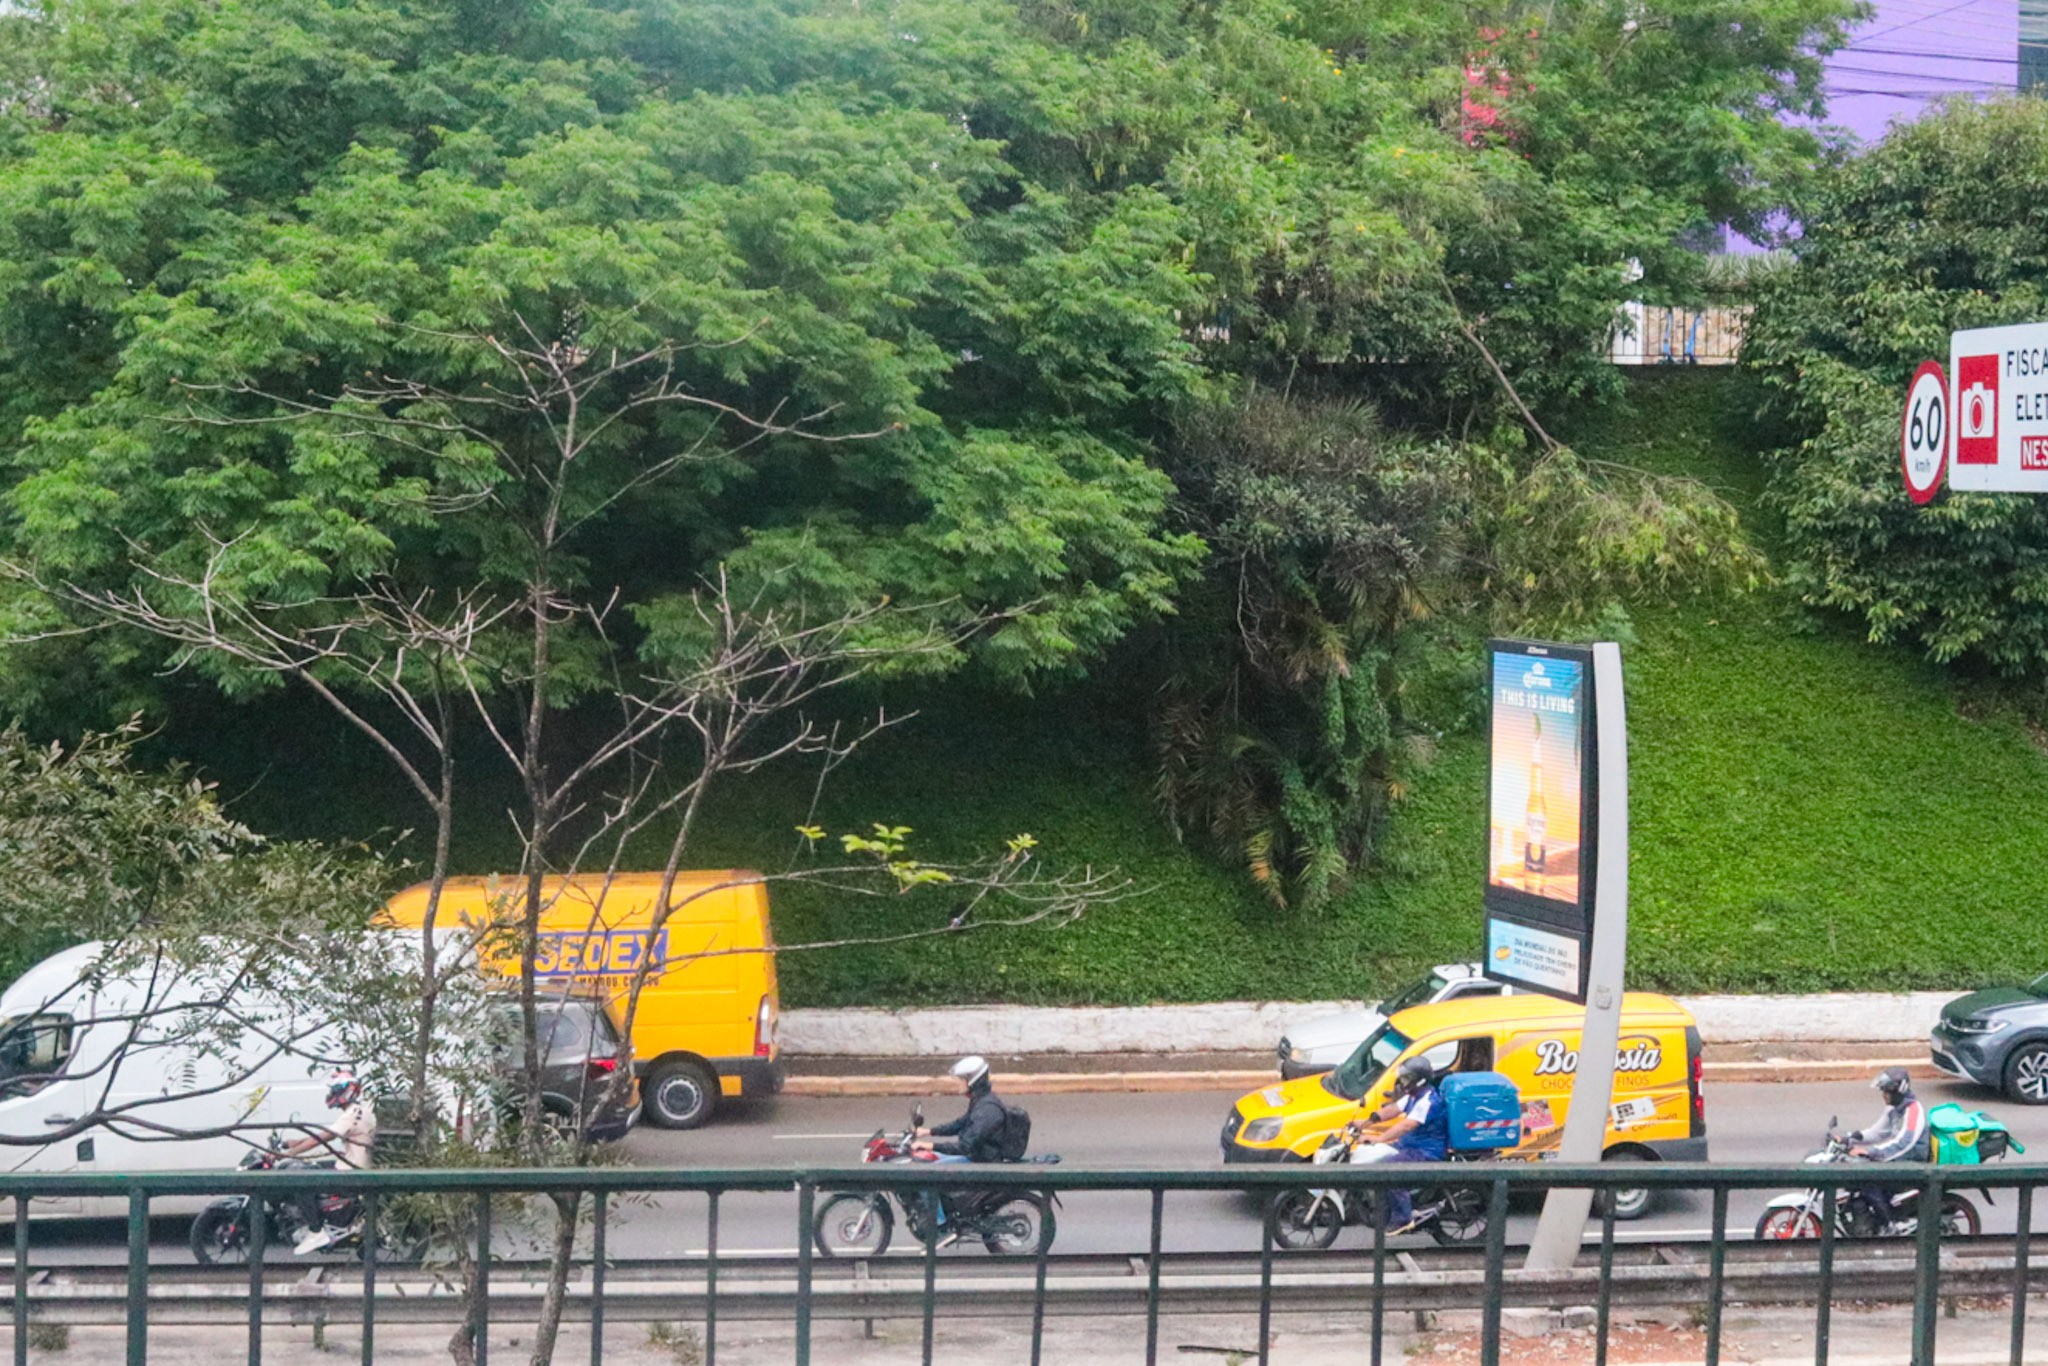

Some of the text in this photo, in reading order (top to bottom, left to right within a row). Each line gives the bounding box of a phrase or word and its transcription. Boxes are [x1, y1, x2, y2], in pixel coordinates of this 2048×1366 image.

[1910, 396, 1942, 451] 60
[1501, 688, 1575, 714] THIS IS LIVING
[534, 934, 662, 972] SEDEX
[1534, 1039, 1661, 1075] Bosia
[1616, 1075, 1650, 1087] FINOS
